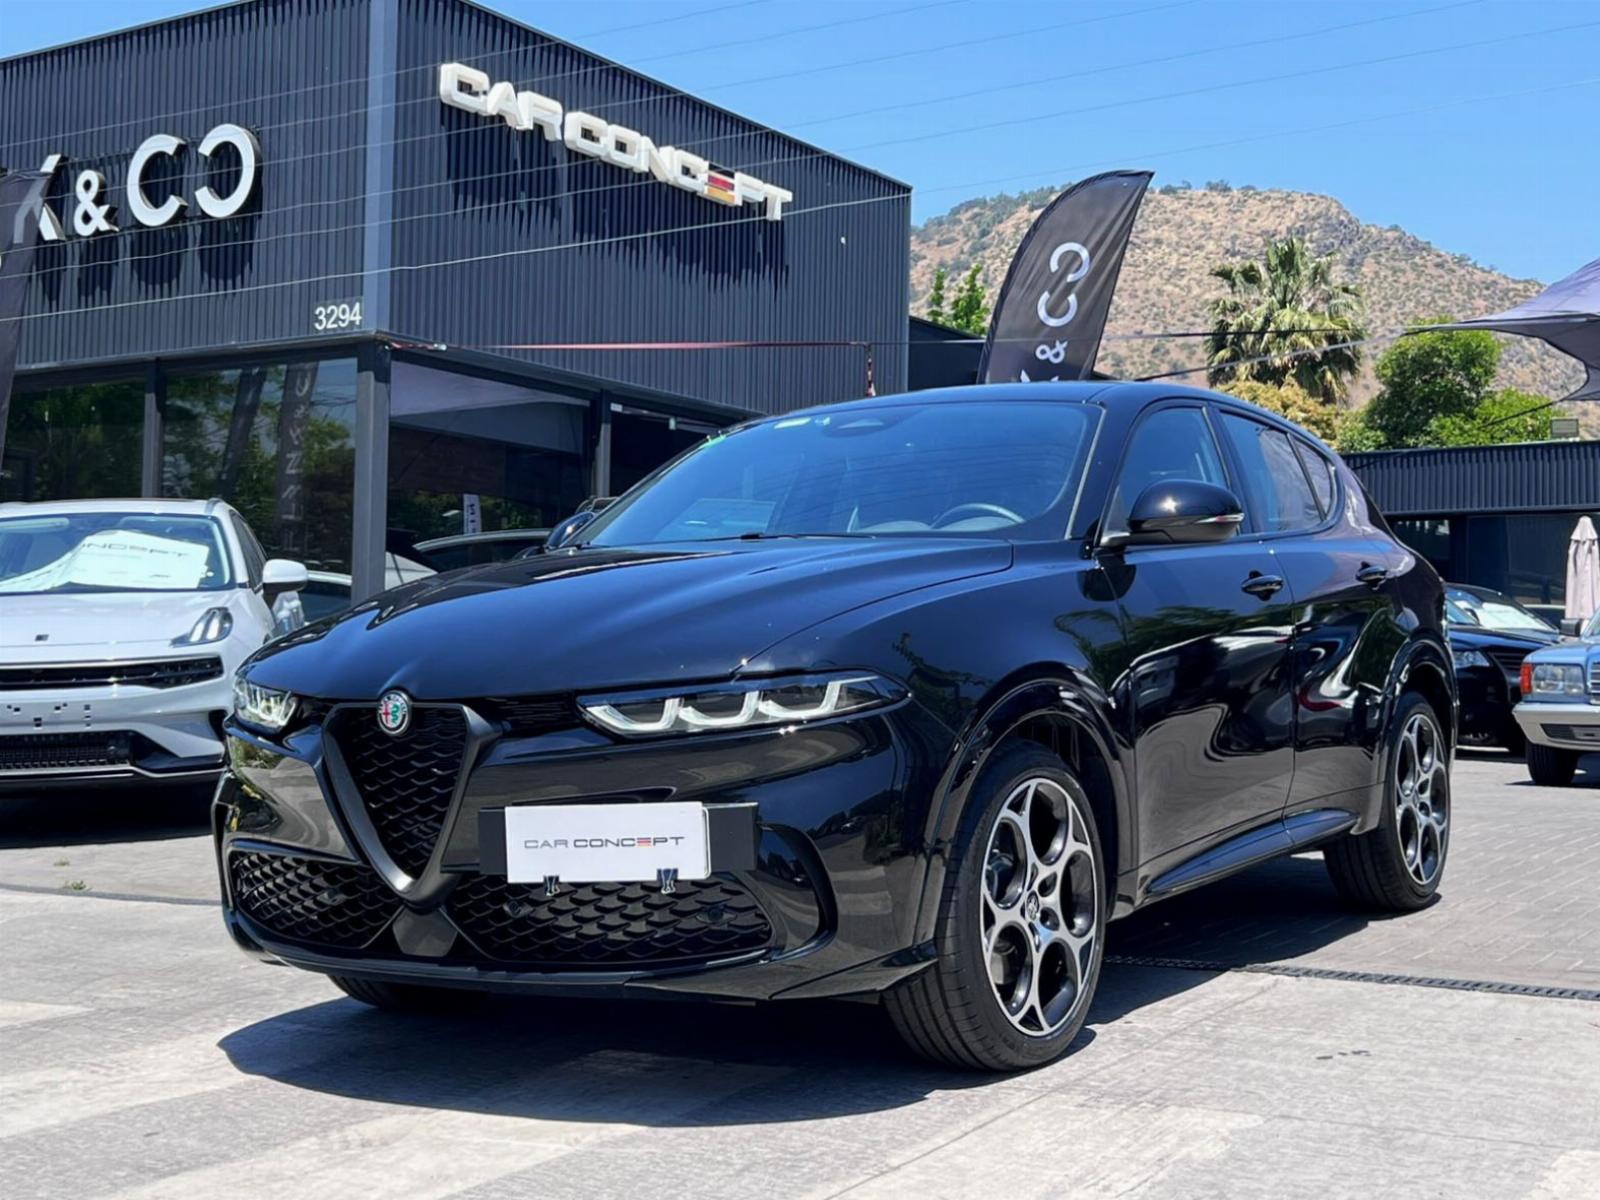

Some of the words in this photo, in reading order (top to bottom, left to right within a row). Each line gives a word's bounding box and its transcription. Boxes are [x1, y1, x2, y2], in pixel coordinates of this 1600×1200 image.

[440, 62, 563, 141] CAR
[564, 111, 793, 221] CONCEPT
[74, 169, 118, 237] &
[313, 302, 363, 331] 3294
[1035, 340, 1068, 364] &
[524, 839, 568, 849] CAR
[573, 836, 685, 849] CONCEPT
